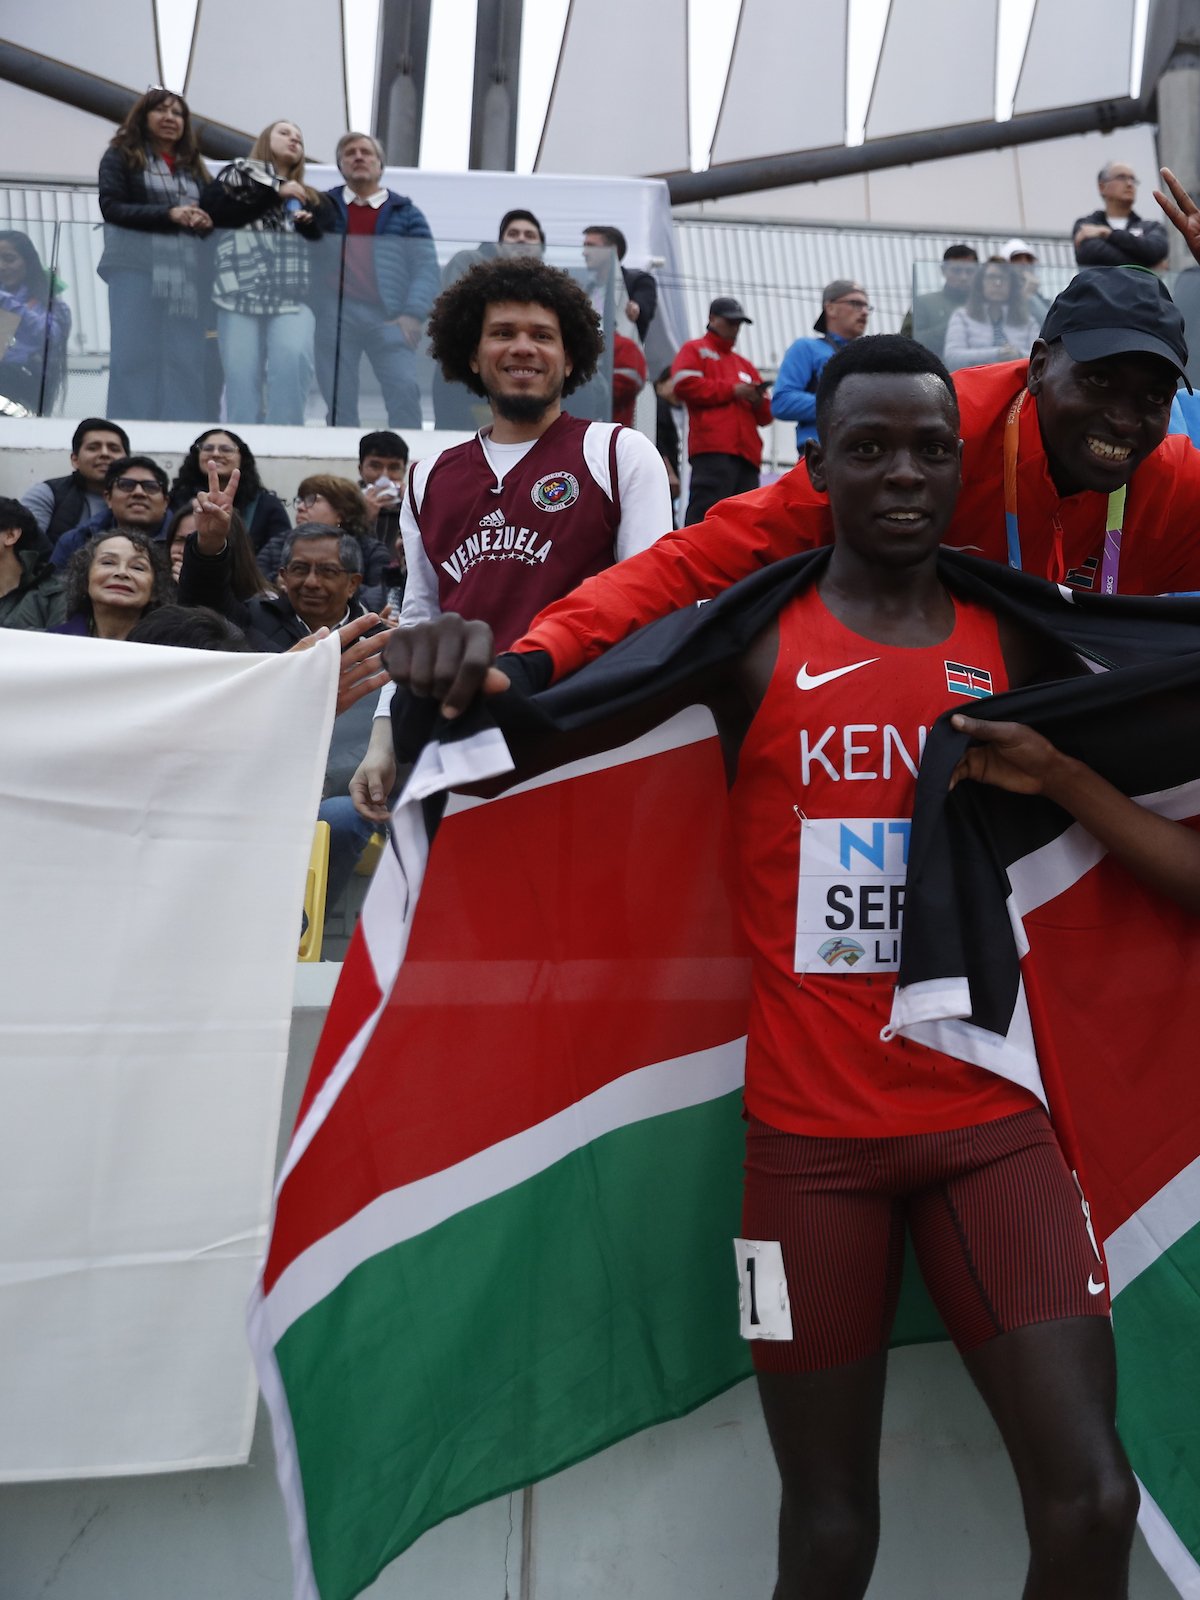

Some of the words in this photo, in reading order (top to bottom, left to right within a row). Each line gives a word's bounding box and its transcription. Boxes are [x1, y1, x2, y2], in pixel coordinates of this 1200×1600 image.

[441, 526, 552, 583] VENEZUELA
[800, 724, 932, 786] KEN
[747, 1257, 760, 1325] 1
